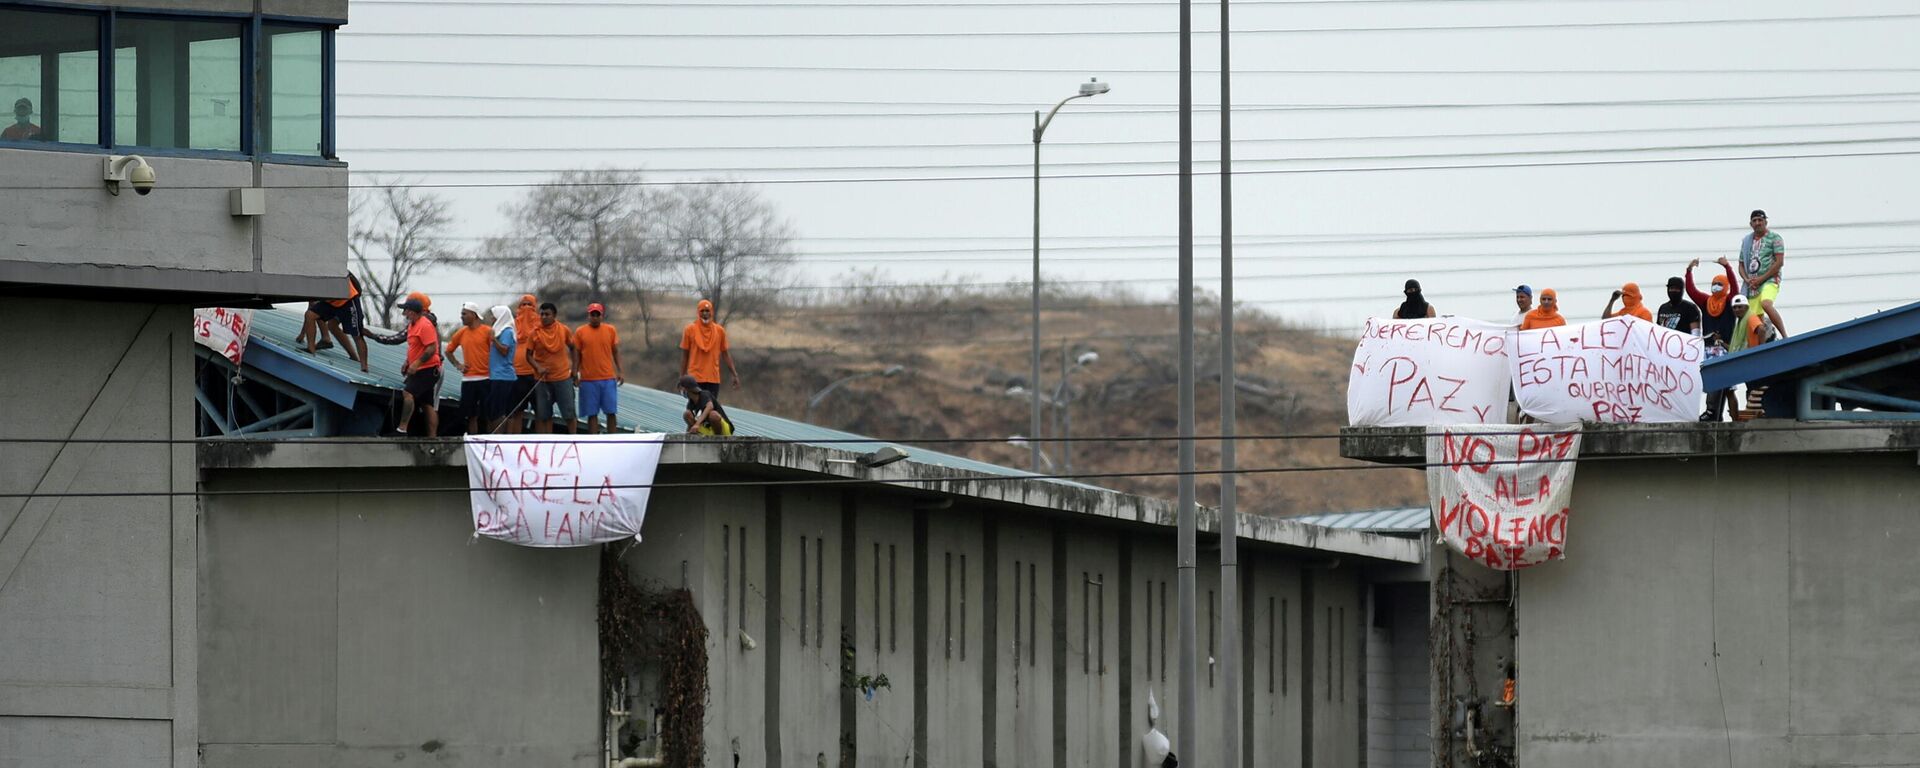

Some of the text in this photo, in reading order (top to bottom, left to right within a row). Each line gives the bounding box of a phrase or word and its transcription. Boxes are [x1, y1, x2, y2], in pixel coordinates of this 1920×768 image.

[1516, 328, 1561, 358] LA
[1648, 326, 1701, 363] NOS
[1379, 356, 1468, 416] PAZ
[1519, 353, 1695, 396] ESTA MATANDO
[1592, 400, 1644, 424] PAZ
[1442, 427, 1577, 474] NO PAZ
[481, 468, 618, 506] VARELA
[1464, 536, 1535, 570] PAZ
